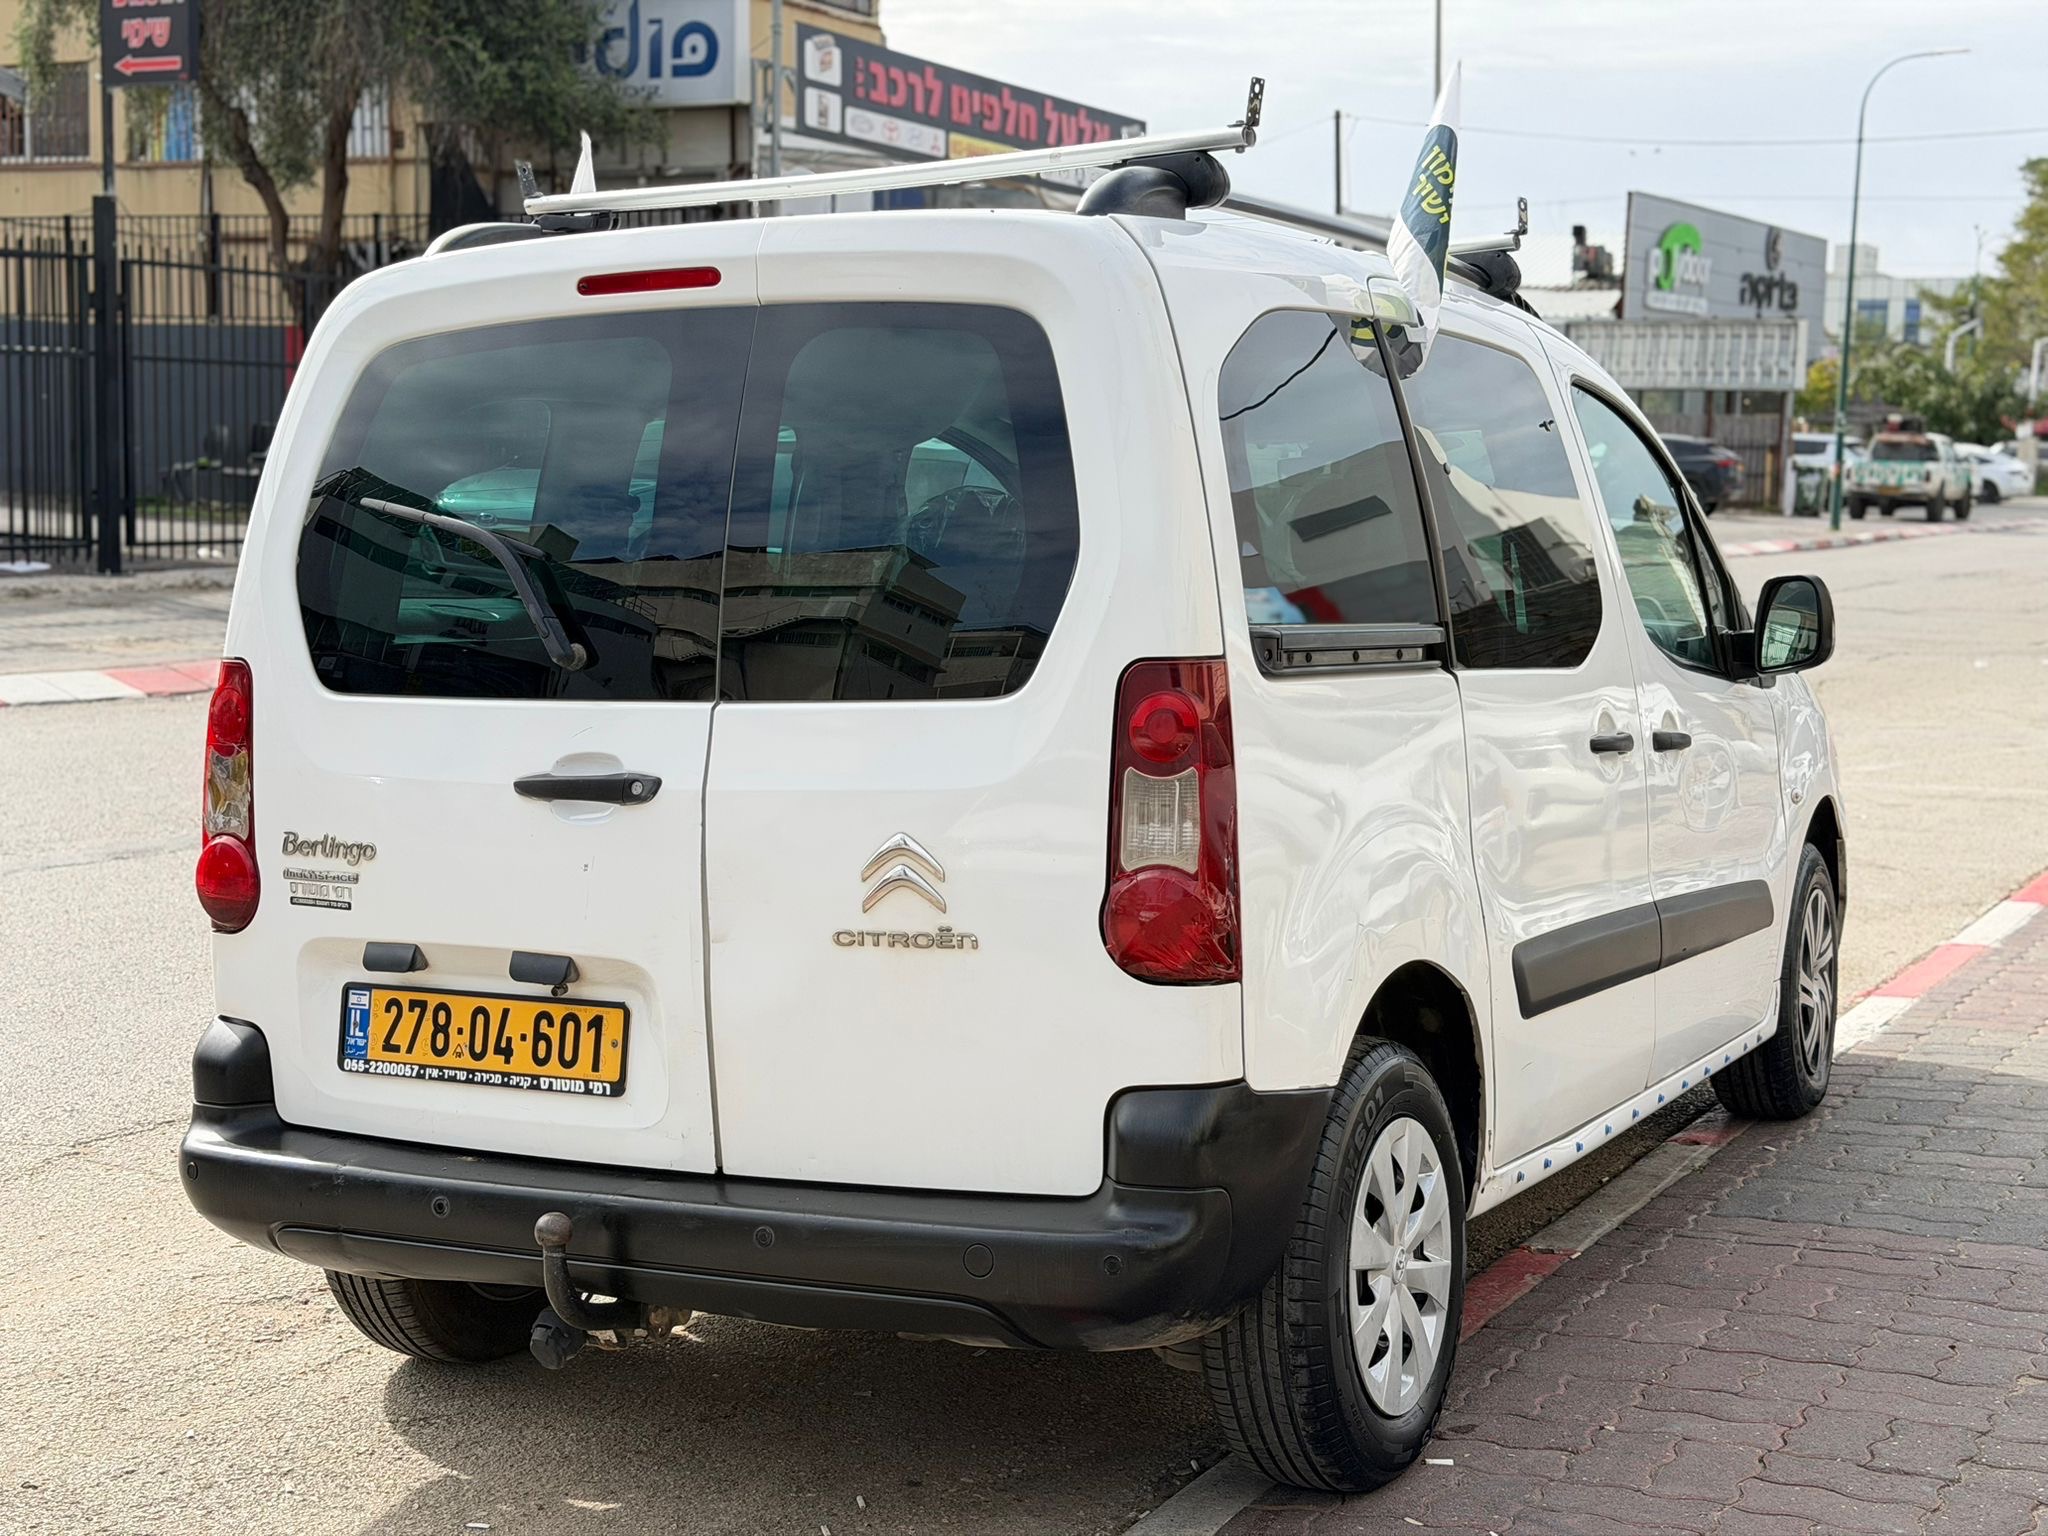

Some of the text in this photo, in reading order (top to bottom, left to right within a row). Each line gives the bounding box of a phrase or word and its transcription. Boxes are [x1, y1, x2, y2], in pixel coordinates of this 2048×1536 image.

[868, 60, 944, 119] לרכב
[950, 84, 1039, 142] חלפים
[1411, 173, 1450, 224] ישיר
[281, 830, 377, 867] Berlingo
[350, 1008, 364, 1037] IL
[343, 1057, 612, 1096] רמי מוטורס קניה מכירה טרייד-אין 055-2200057
